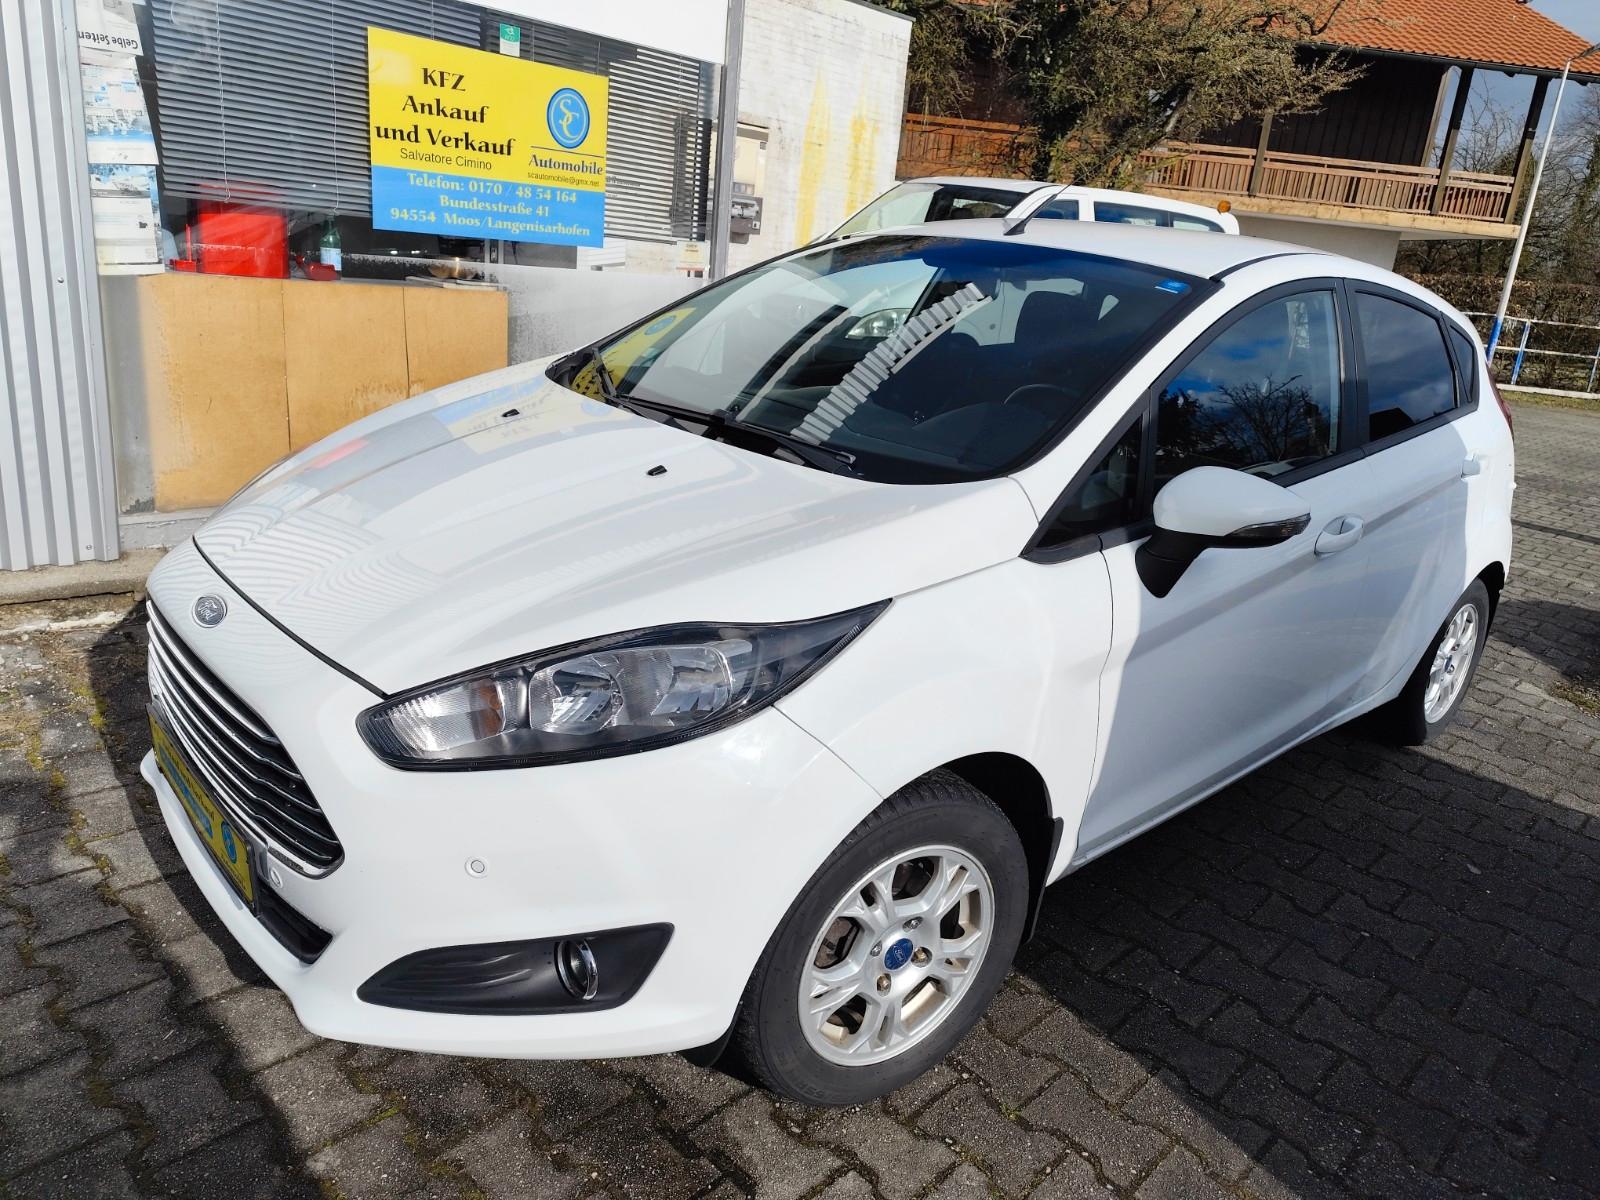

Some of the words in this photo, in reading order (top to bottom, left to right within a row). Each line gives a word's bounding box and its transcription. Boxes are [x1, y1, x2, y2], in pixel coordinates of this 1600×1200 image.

[78, 31, 111, 45] Seiten
[111, 37, 139, 50] Gelbe
[421, 67, 466, 92] KFZ
[402, 95, 490, 124] Ankauf
[375, 125, 421, 144] und
[425, 127, 517, 157] Verkauf
[400, 147, 453, 166] Salvatore
[455, 155, 493, 171] Cimino
[528, 154, 603, 176] Automobile
[407, 172, 465, 191] Telefon:
[468, 181, 502, 196] 0170
[516, 186, 532, 199] 48
[535, 189, 552, 201] 54
[556, 190, 577, 204] 164
[440, 195, 533, 217] Bundesstraße
[535, 204, 550, 217] 41
[390, 207, 436, 223] 94554
[443, 211, 591, 237] Moos/Langenisarhofen
